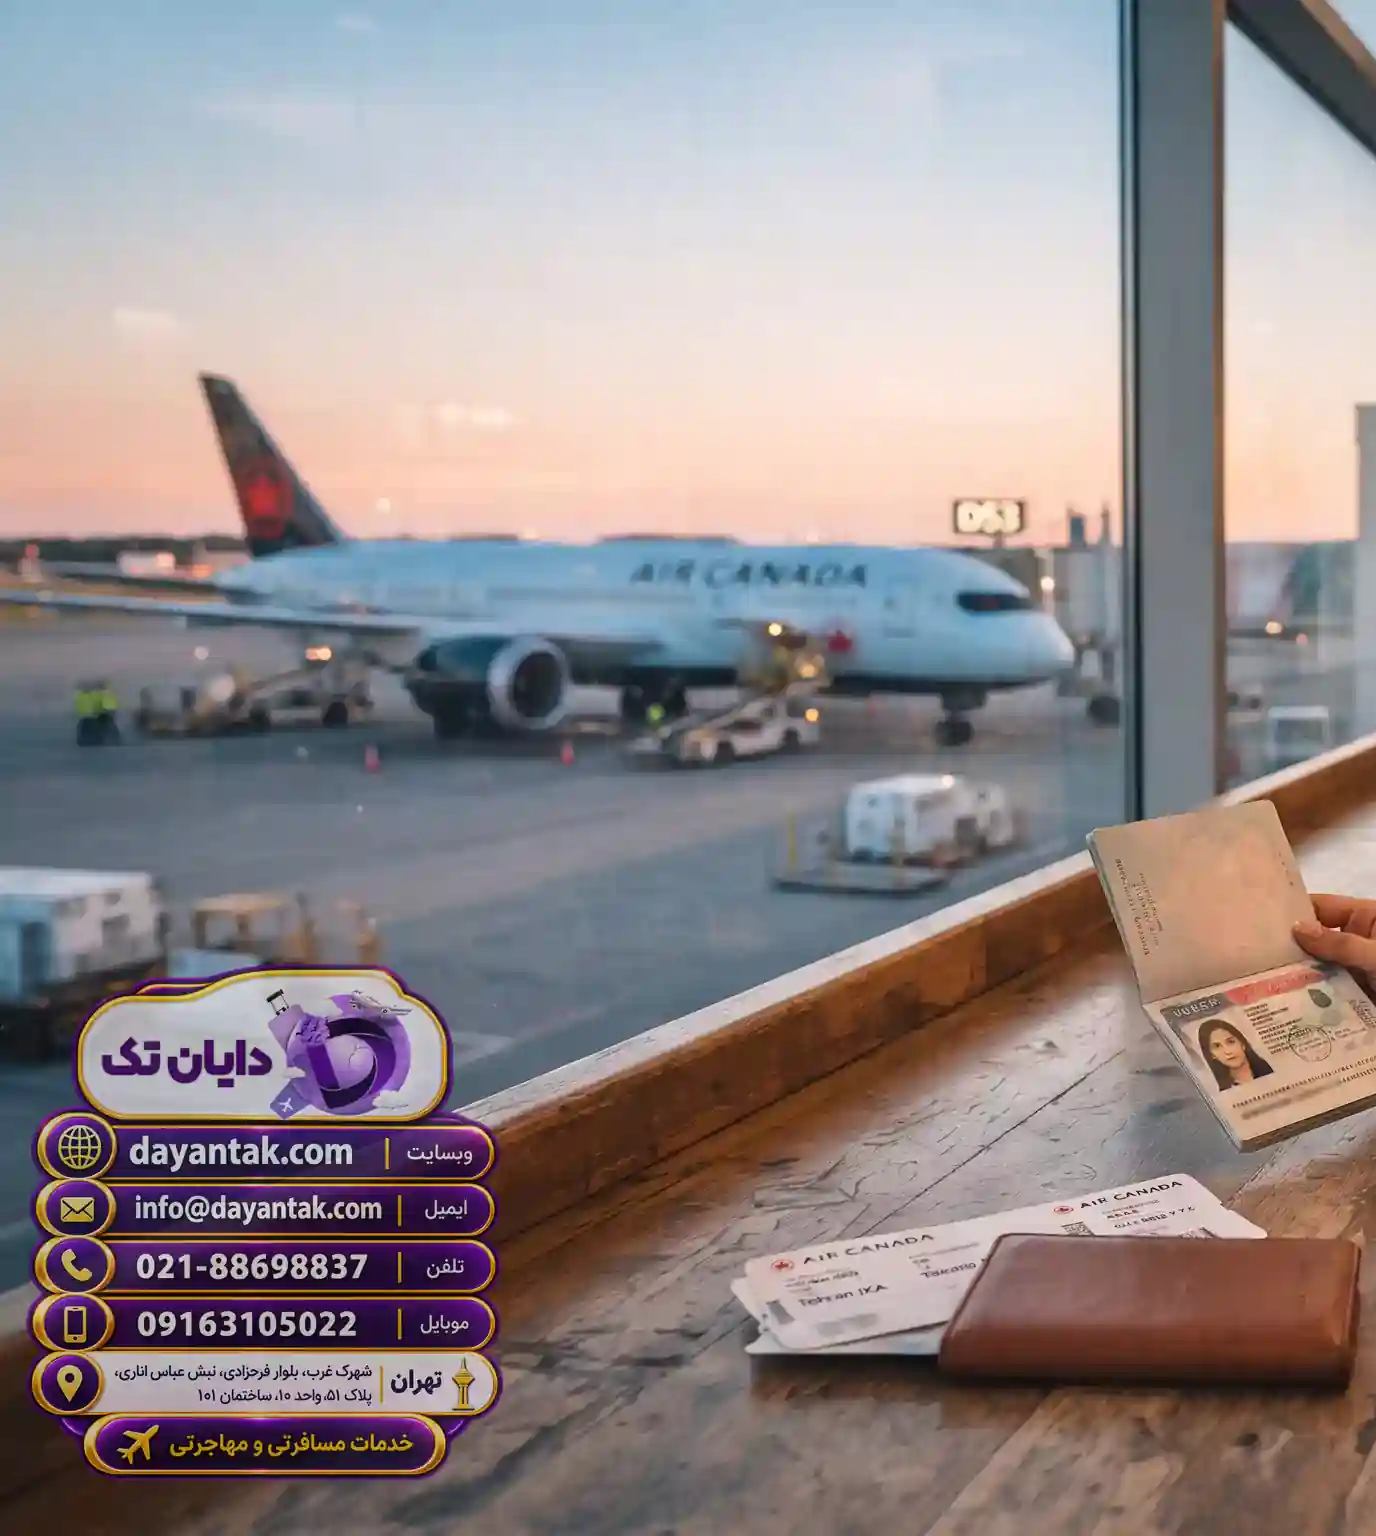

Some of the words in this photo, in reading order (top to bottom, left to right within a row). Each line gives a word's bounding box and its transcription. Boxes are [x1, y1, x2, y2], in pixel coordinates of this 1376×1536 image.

[630, 558, 696, 584] AIR
[703, 562, 868, 588] CANADA
[1081, 1197, 1108, 1209] AIR
[1113, 1180, 1183, 1201] CANADA
[803, 1251, 839, 1265] AIR
[844, 1233, 935, 1257] CANADA
[798, 1290, 854, 1307] Tehran
[858, 1284, 889, 1296] IKA
